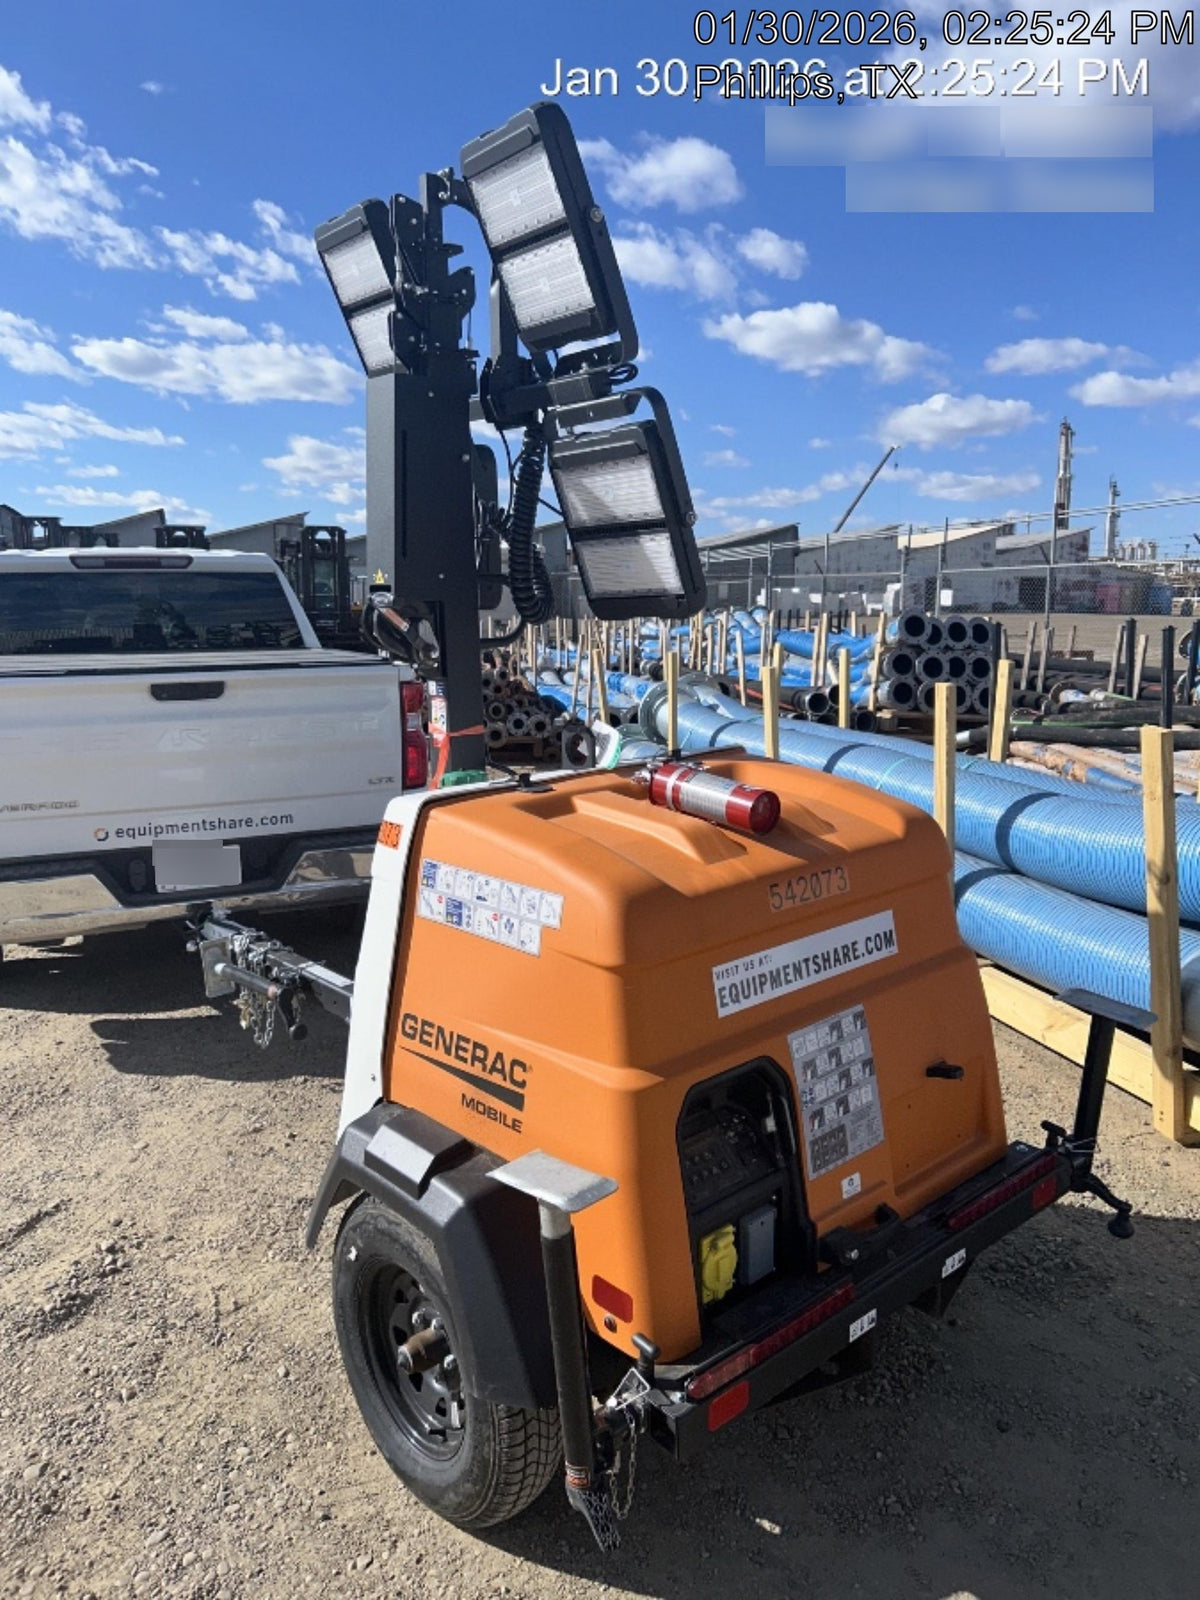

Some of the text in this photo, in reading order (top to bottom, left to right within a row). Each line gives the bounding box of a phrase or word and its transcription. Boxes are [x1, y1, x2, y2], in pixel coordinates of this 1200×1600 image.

[115, 813, 294, 840] equipmentshare.com
[768, 866, 848, 911] 542073
[714, 954, 773, 981] VISIT US AT:
[717, 929, 895, 1008] EQUIPMENTSHARE.COM
[401, 1012, 527, 1089] GENERAC
[461, 1093, 523, 1134] MOBILE
